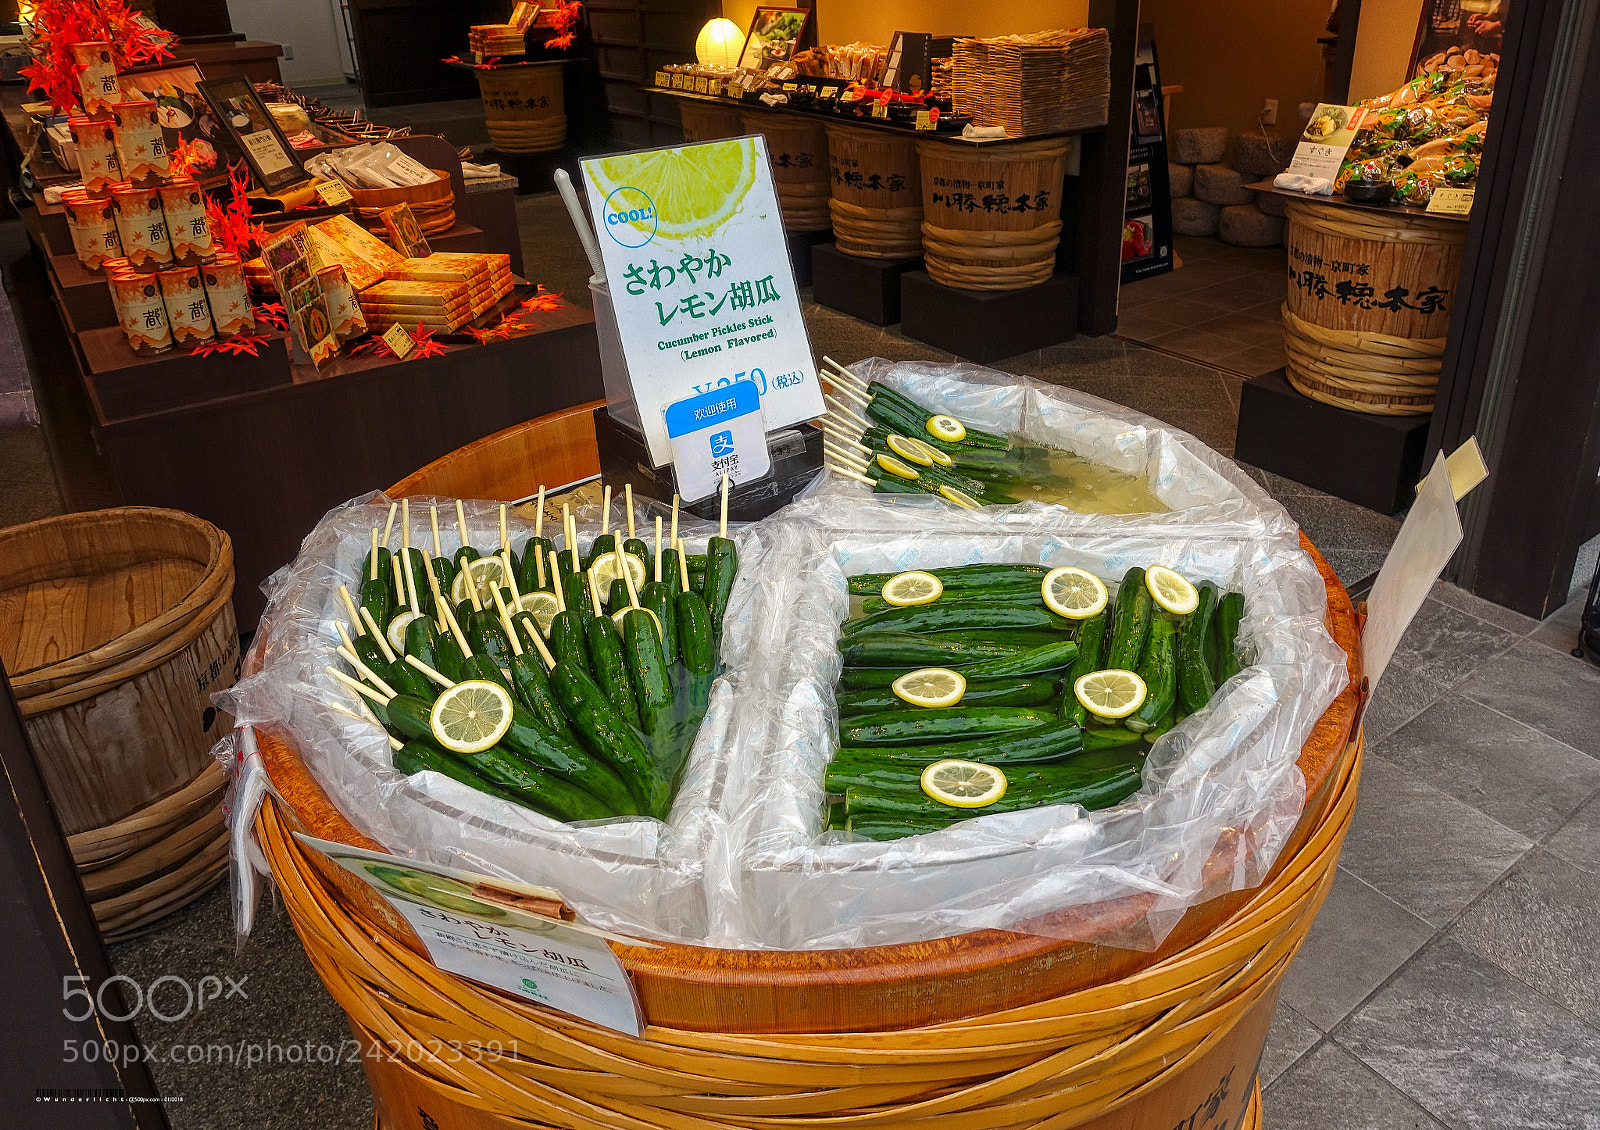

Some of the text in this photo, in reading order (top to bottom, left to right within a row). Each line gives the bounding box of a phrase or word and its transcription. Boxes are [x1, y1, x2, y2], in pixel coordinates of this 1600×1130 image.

[608, 207, 653, 226] COOL!
[623, 249, 732, 295] さわやか
[655, 275, 781, 327] レモン胡瓜
[657, 314, 774, 351] Cucumber Pickles Stick
[681, 327, 778, 362] (Lemon Flavored)
[694, 397, 737, 421] 欢迎使用
[712, 454, 739, 472] 支付宝
[417, 907, 509, 937] さわやか
[474, 930, 591, 971] レモン胡瓜
